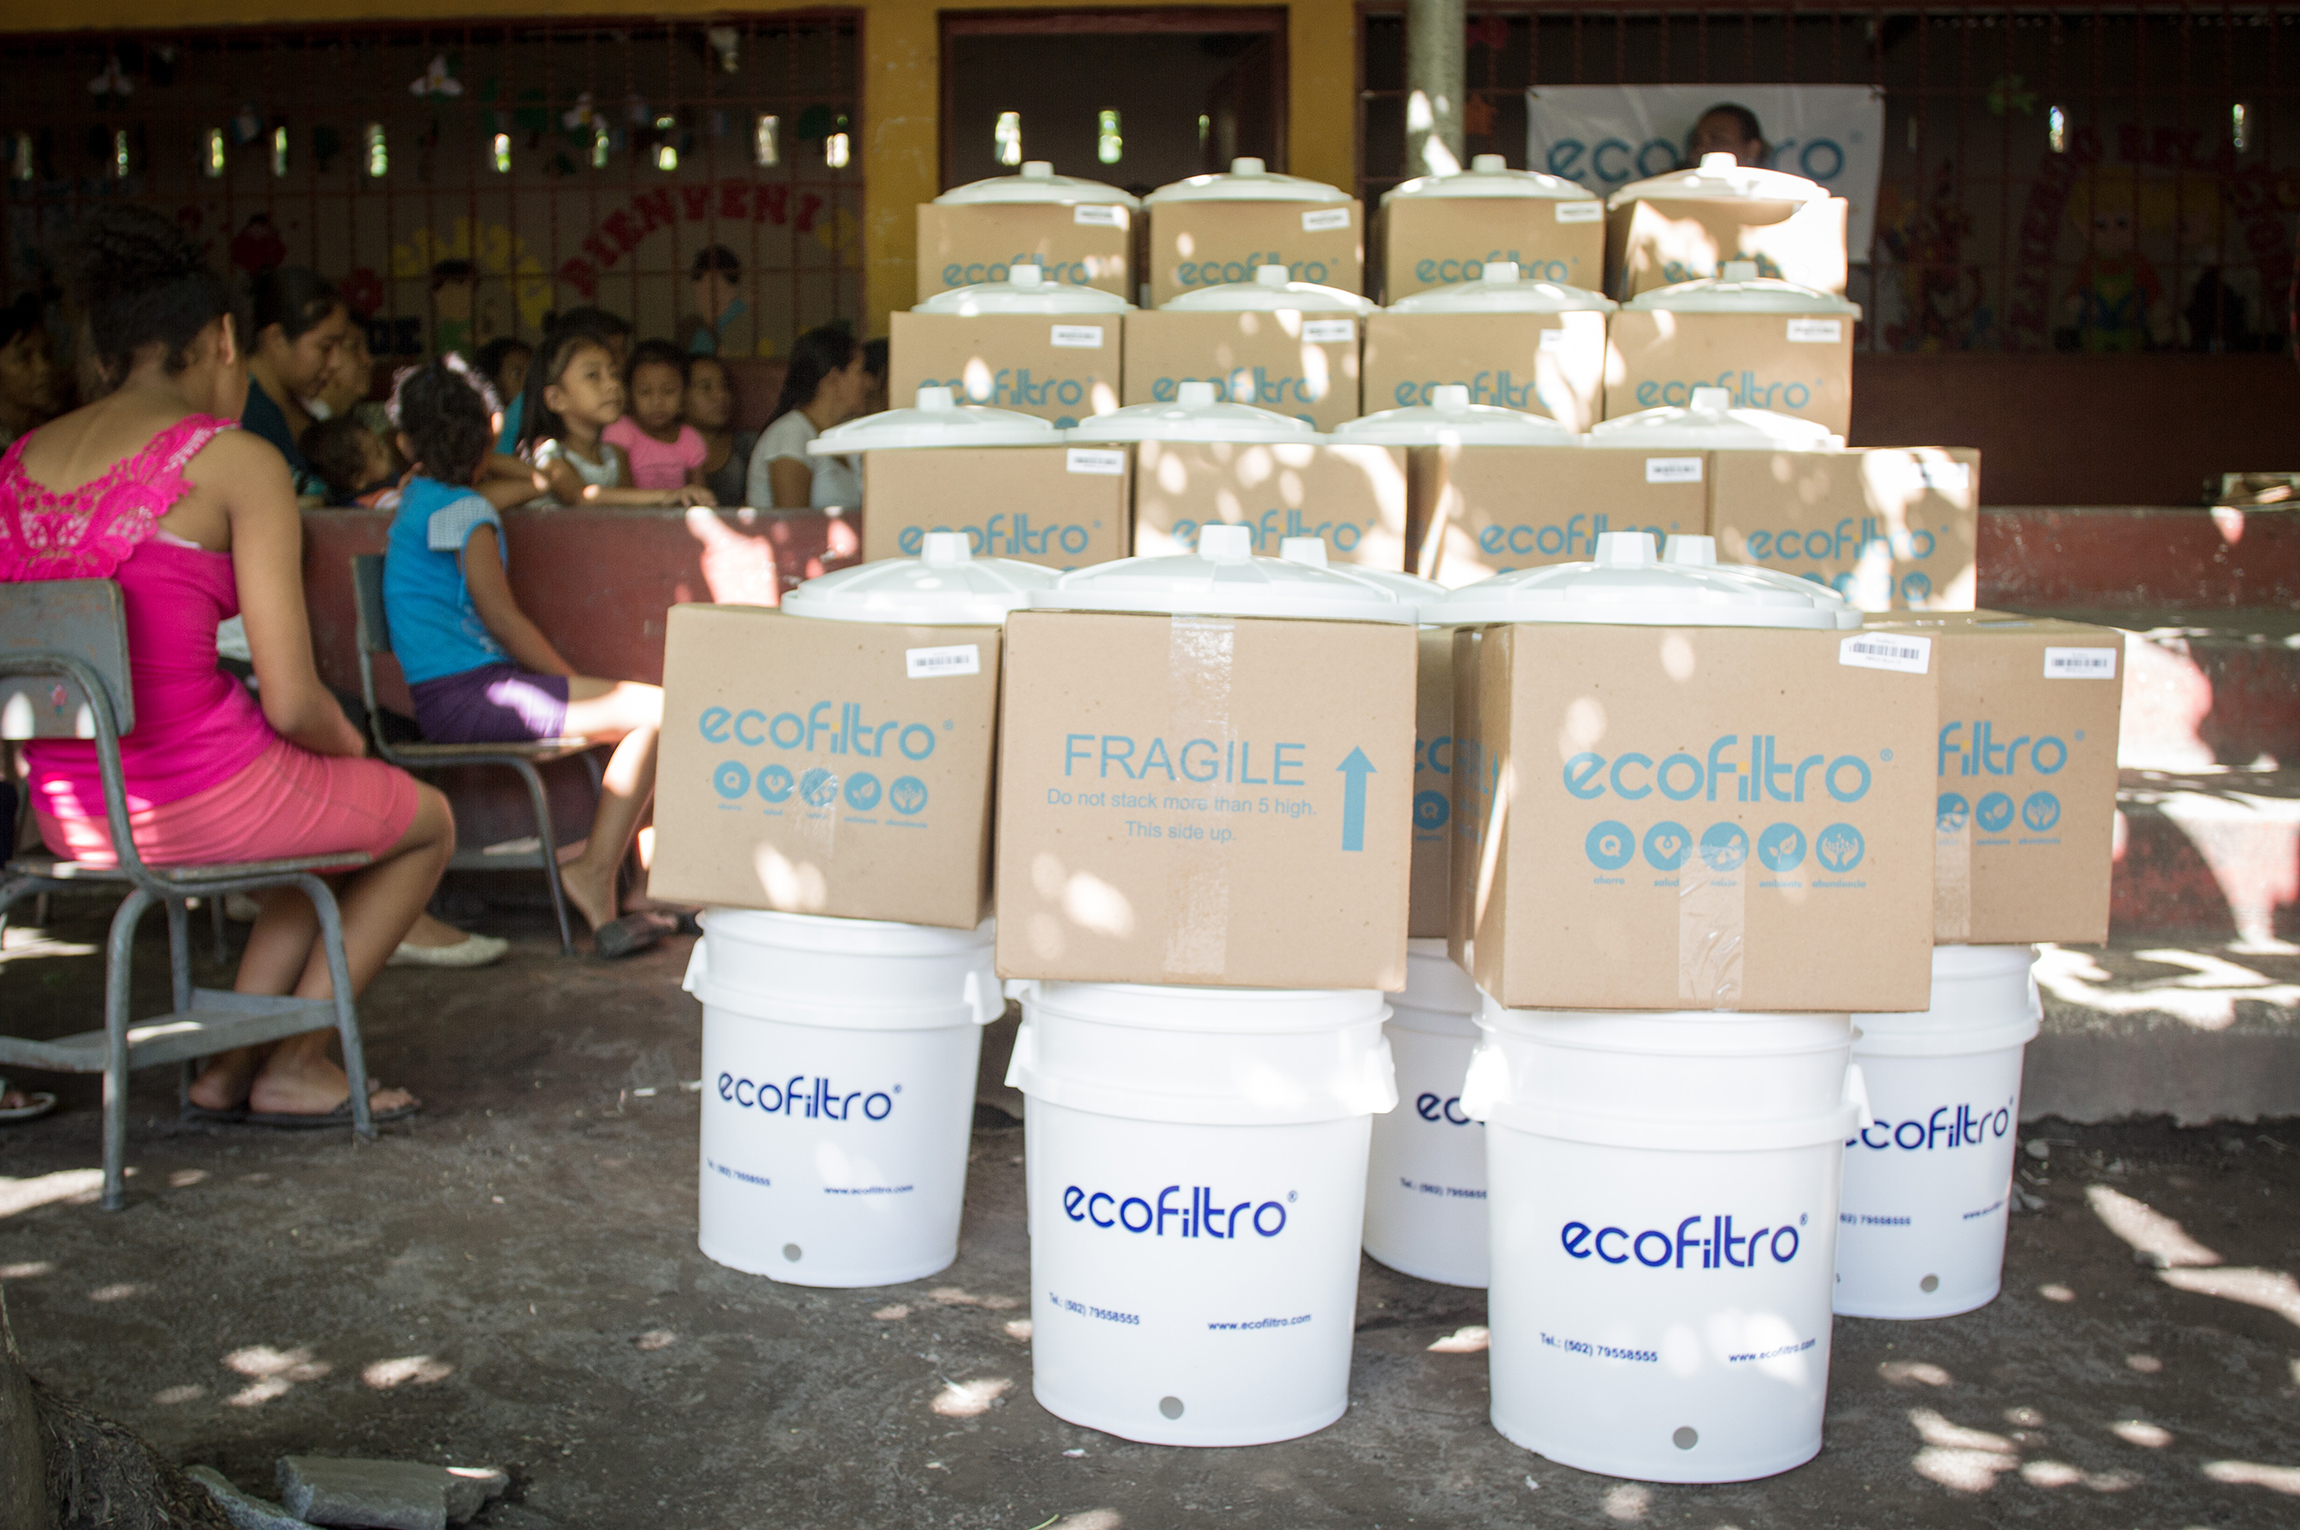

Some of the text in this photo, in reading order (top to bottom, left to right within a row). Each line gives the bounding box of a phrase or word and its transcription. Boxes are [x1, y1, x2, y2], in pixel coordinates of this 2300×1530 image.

[699, 700, 936, 761] ecofiltro
[1937, 720, 2068, 777] filtro
[1065, 733, 1306, 786] FRAGILE
[1563, 735, 1872, 803] ecofiltro
[1047, 788, 1317, 819] Do not stack more than 5 high.
[1125, 820, 1237, 844] This side up.
[1593, 875, 1626, 885] ahorro
[1654, 877, 1680, 888] salud
[1811, 879, 1867, 889] abundancia
[718, 1072, 893, 1122] ecofiltro
[1063, 1185, 1287, 1239] ecofiltro
[1561, 1215, 1800, 1269] ecofiltro
[1064, 1299, 1087, 1318] (502)
[1208, 1313, 1312, 1331] www.ecofiltro.com
[1564, 1340, 1594, 1358] (502)
[1597, 1345, 1659, 1363] 79558555
